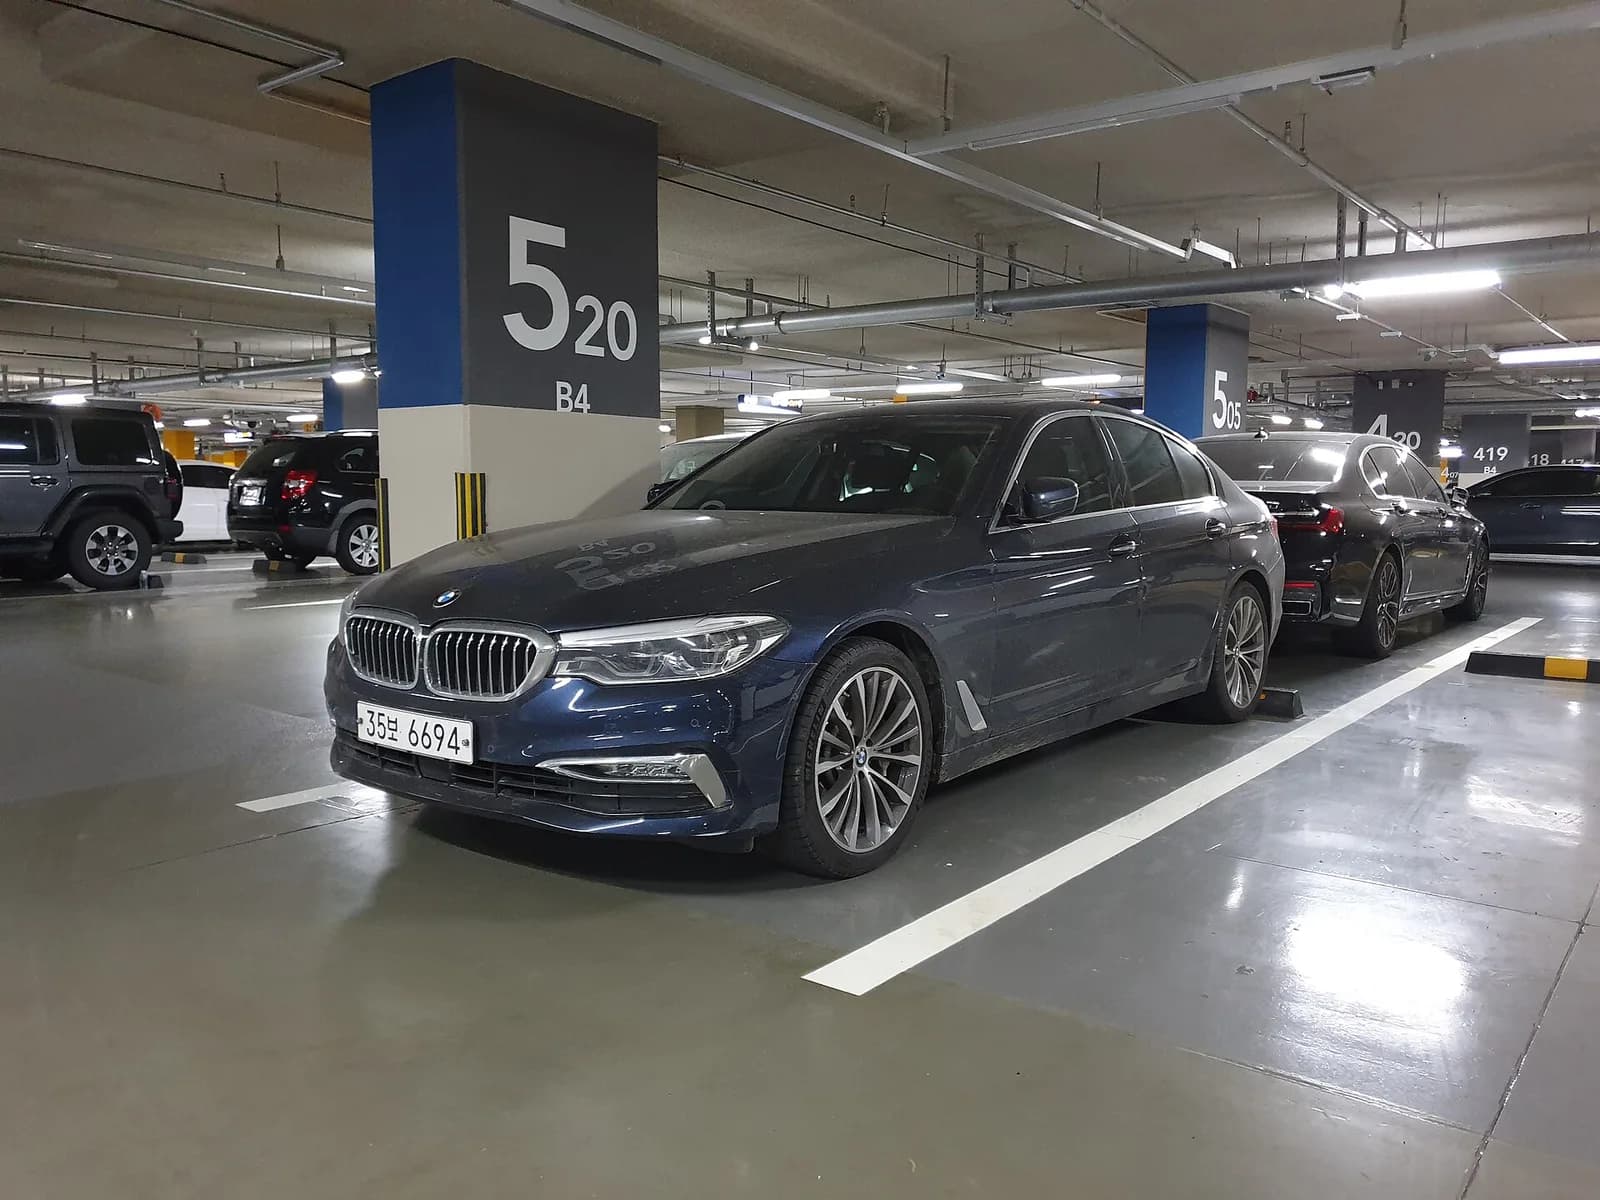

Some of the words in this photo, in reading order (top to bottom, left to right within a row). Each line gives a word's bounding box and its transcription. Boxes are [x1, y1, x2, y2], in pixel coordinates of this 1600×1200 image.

[556, 380, 591, 414] B4
[1473, 446, 1509, 461] 419
[1527, 453, 1550, 466] 18
[1483, 466, 1497, 474] B4
[366, 709, 398, 741] 35보
[408, 719, 460, 755] 6694
